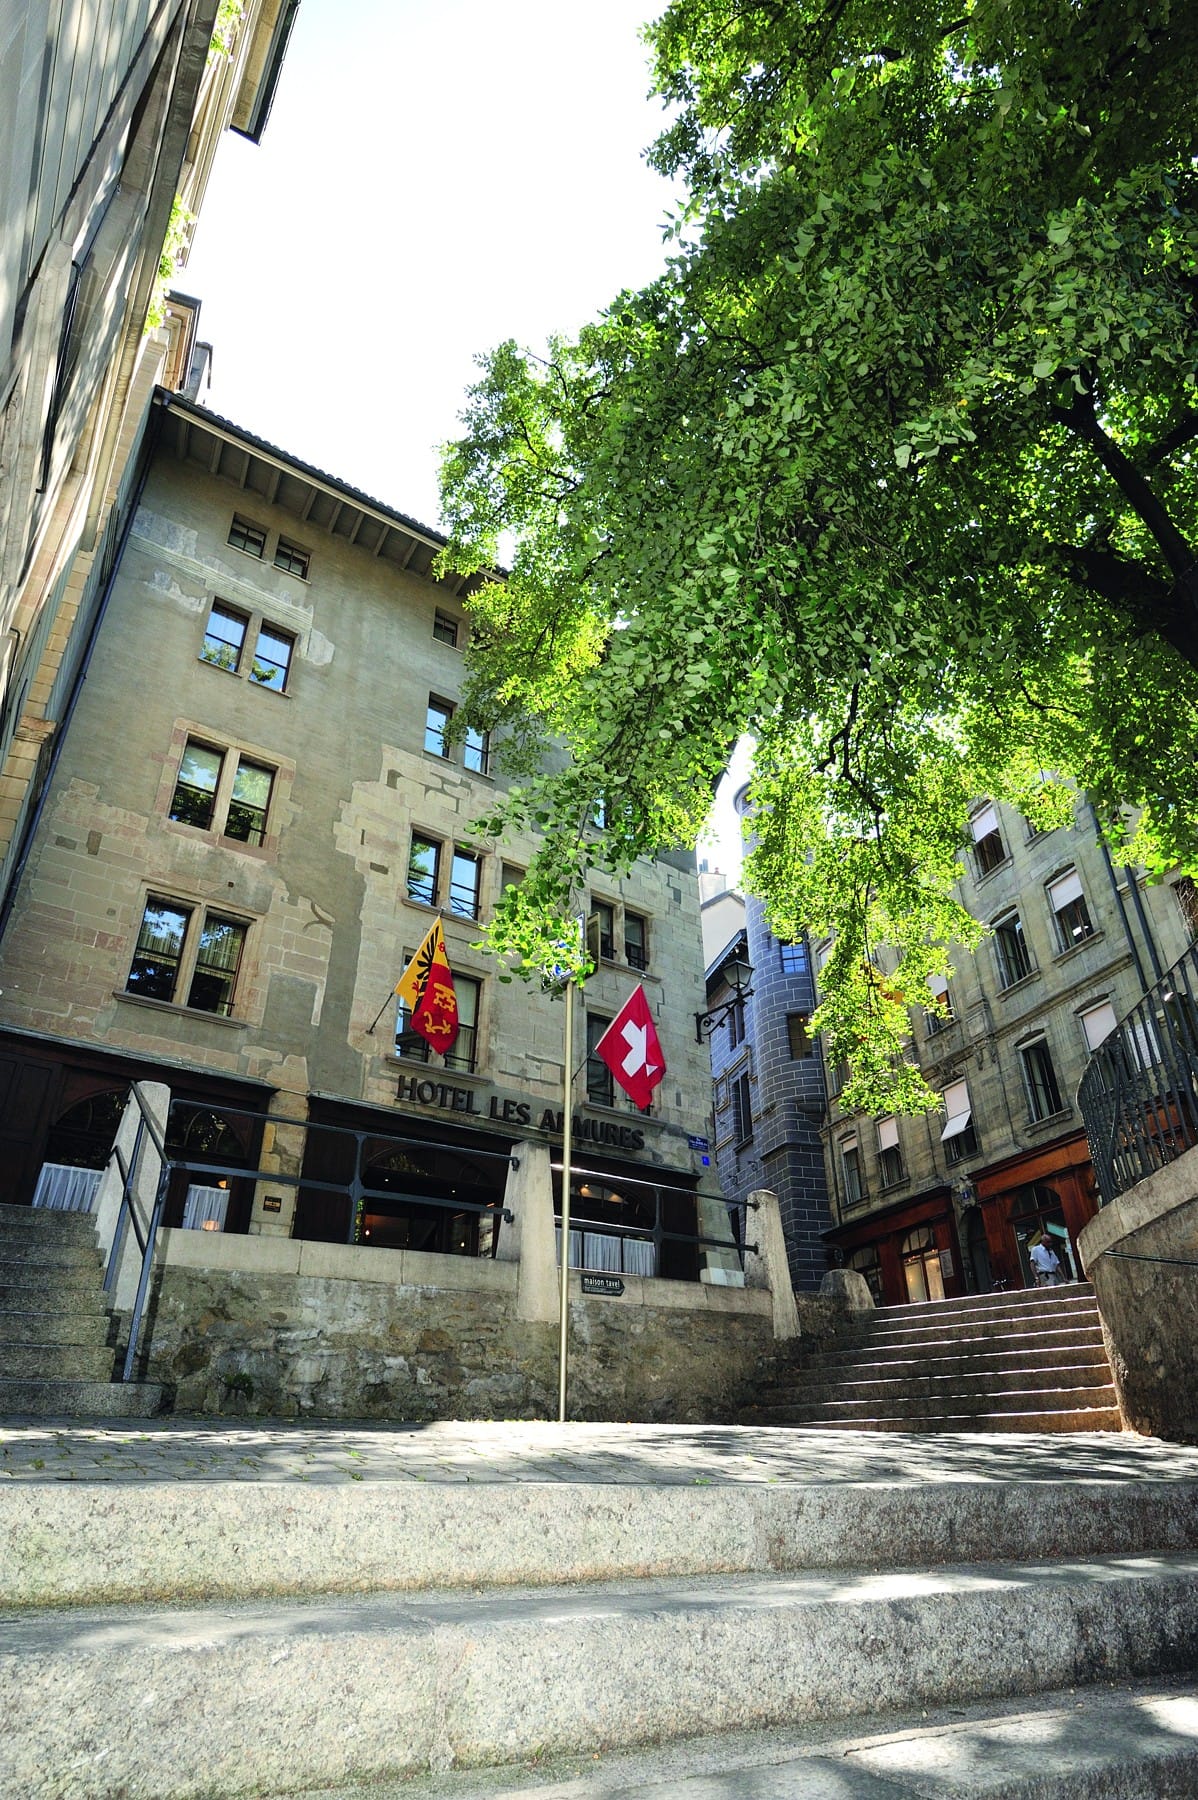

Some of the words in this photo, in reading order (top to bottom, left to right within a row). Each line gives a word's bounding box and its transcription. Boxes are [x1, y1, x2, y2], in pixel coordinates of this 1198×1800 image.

[396, 1074, 481, 1115] HOTEL
[489, 1095, 531, 1125] LES
[583, 1276, 605, 1286] maison
[605, 1279, 620, 1288] tavel
